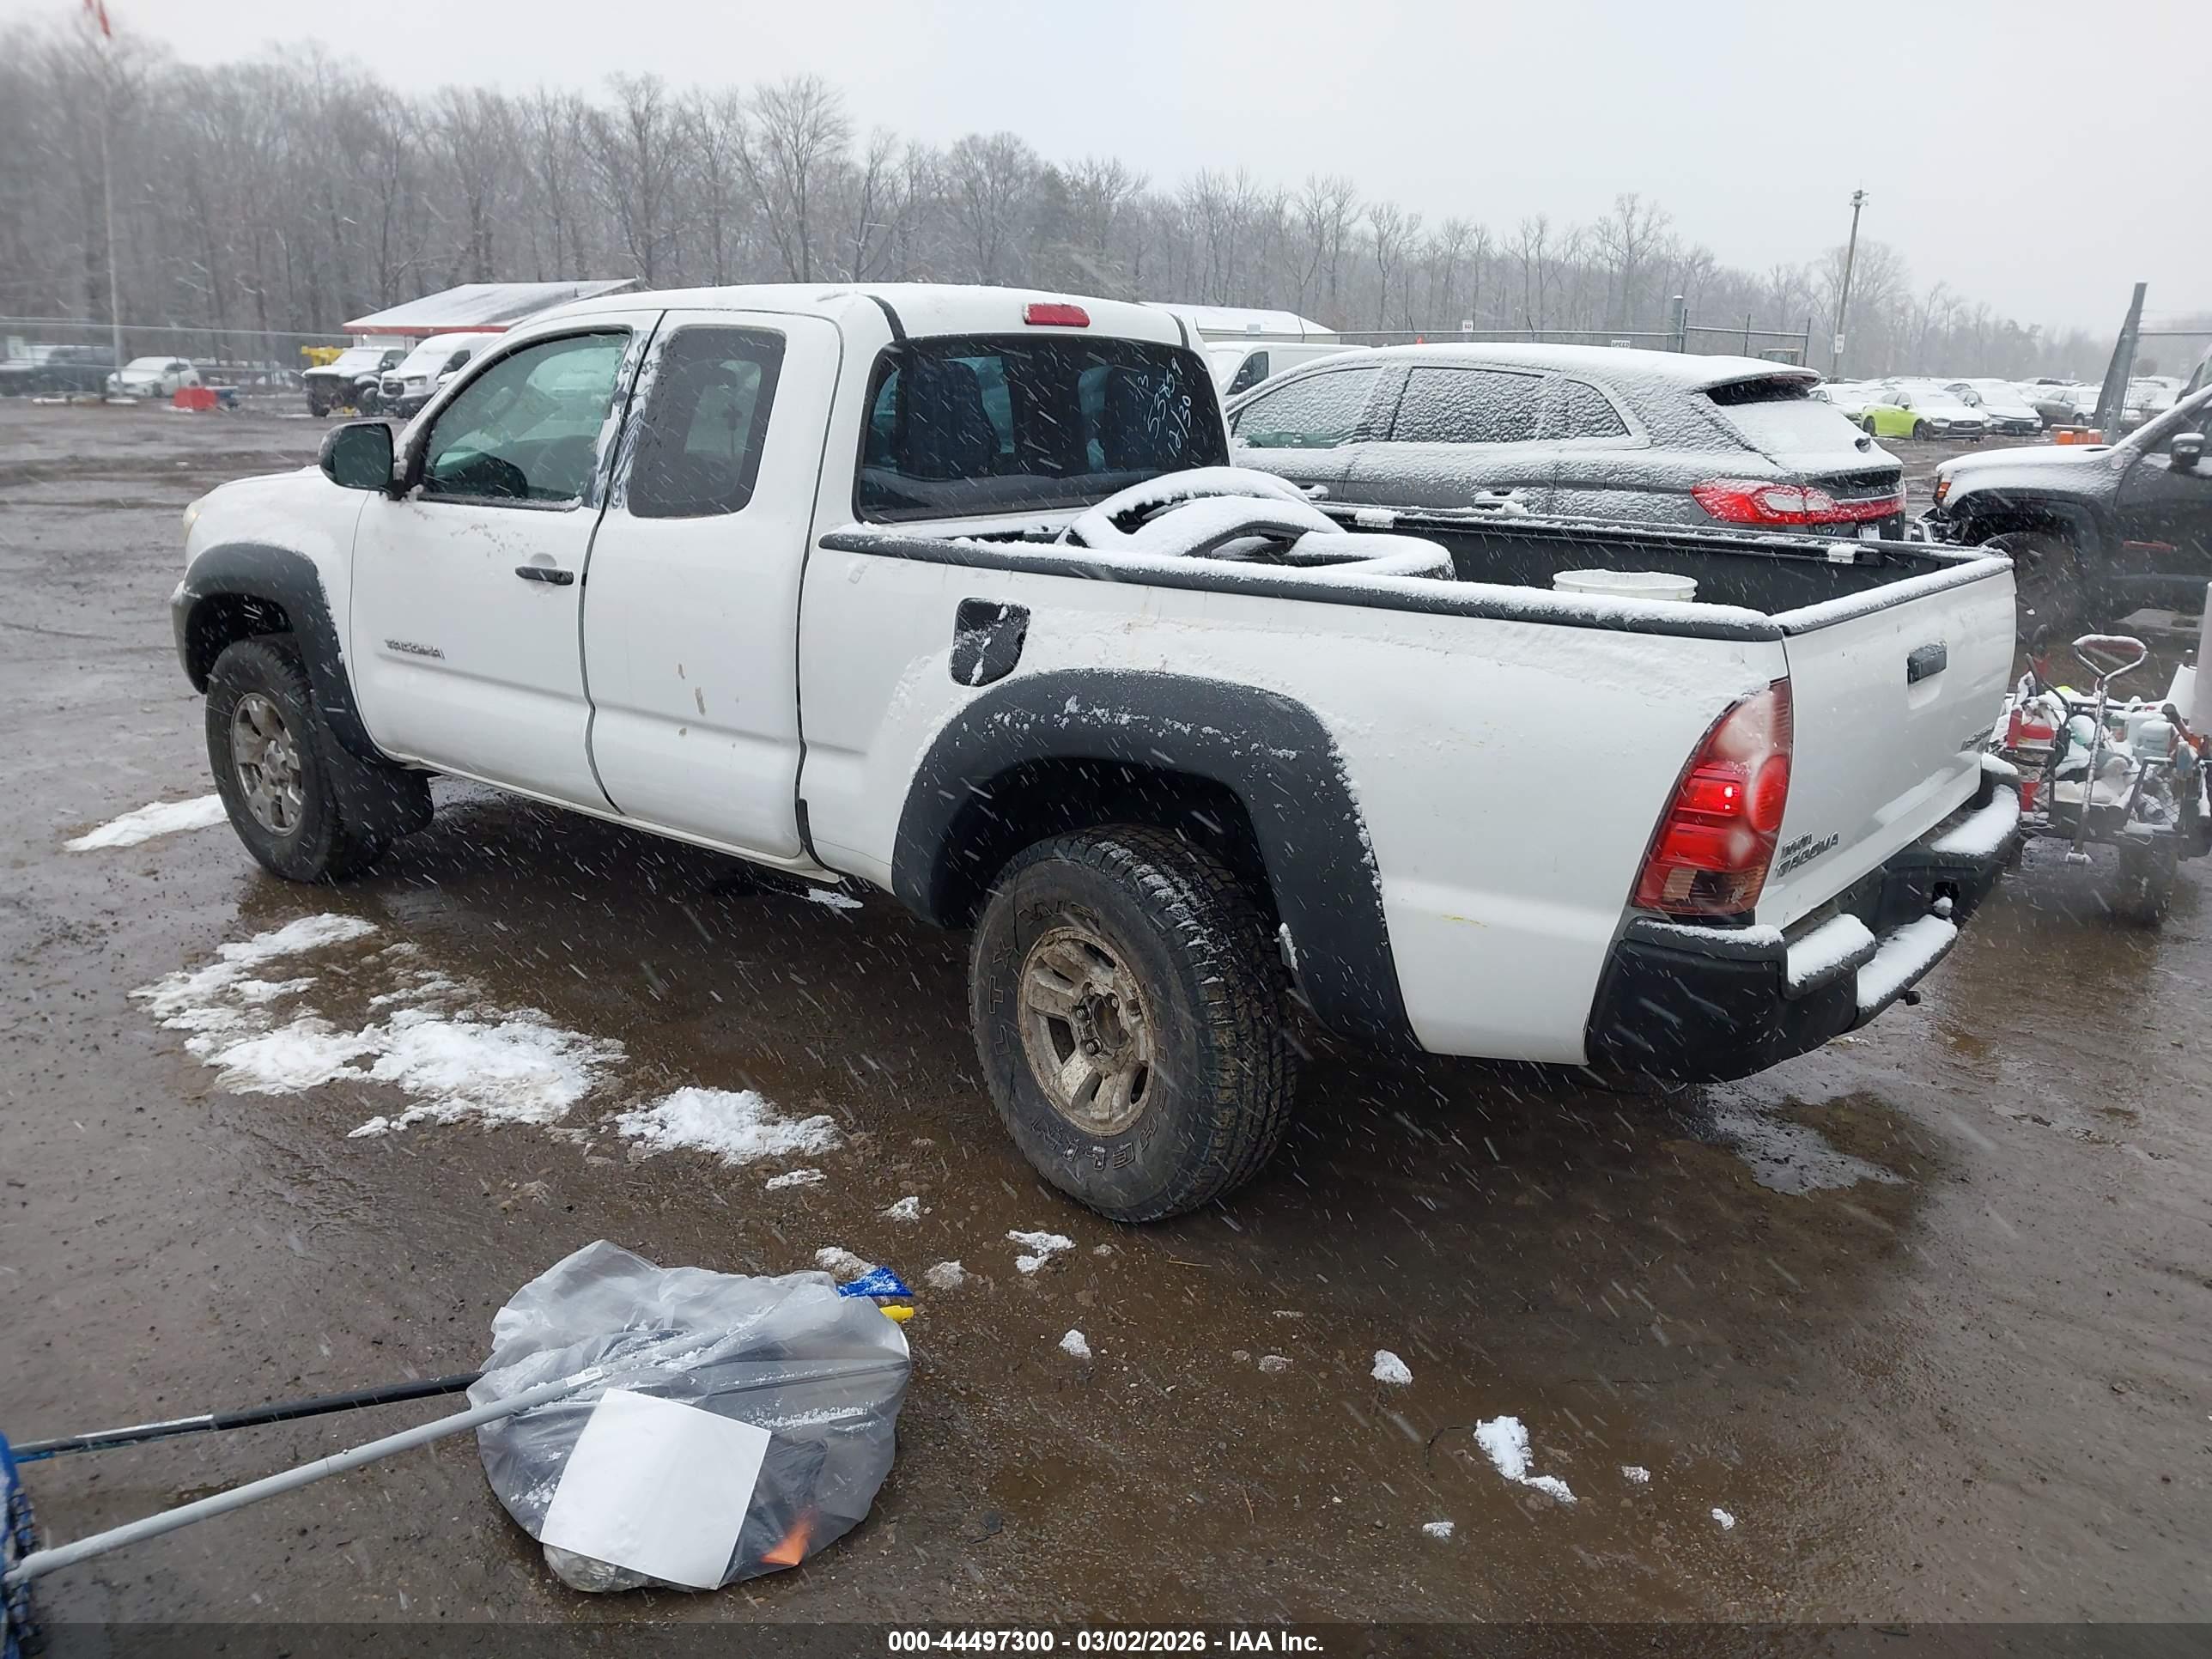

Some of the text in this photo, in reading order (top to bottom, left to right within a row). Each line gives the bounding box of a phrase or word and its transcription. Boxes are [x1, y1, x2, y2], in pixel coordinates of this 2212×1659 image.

[1147, 357, 1182, 440] 53859
[1168, 395, 1192, 458] 12/30
[1775, 831, 1839, 879] TACOMA
[988, 940, 1016, 1056] LTX
